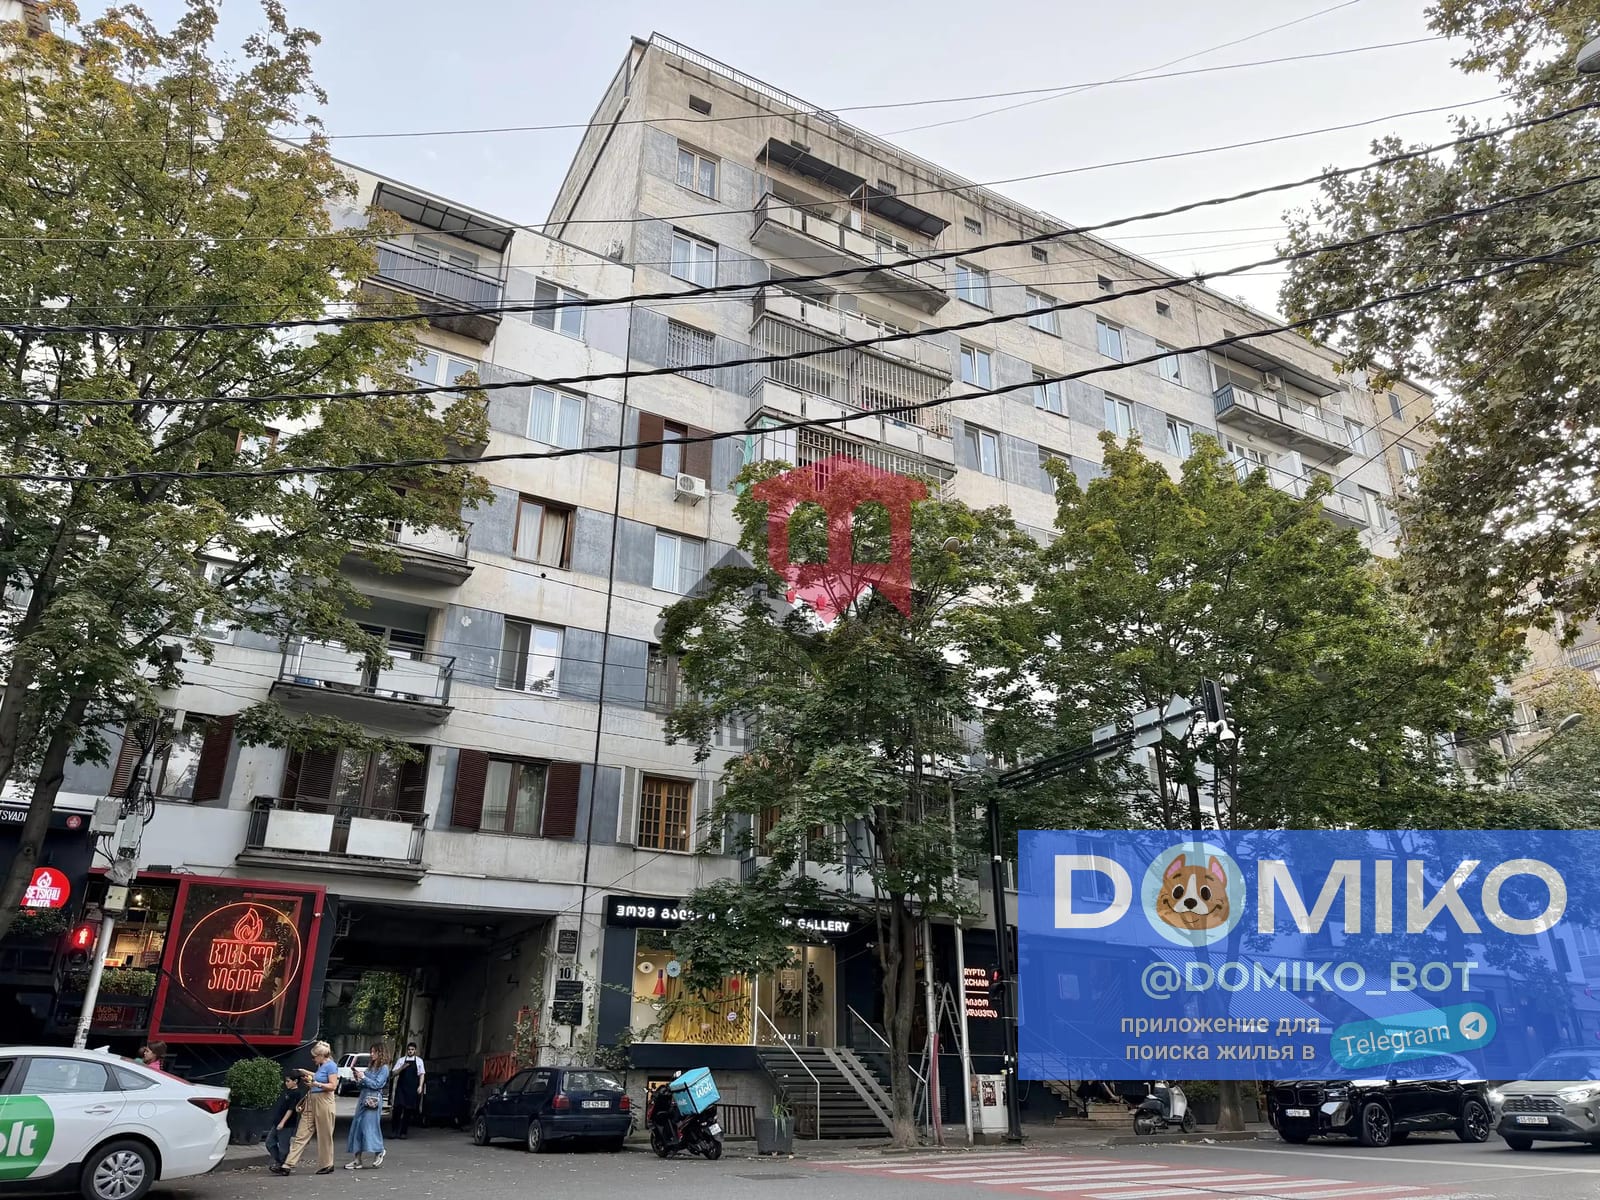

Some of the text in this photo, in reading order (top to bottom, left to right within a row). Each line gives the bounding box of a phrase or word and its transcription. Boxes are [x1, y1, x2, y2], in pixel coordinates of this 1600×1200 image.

[616, 904, 656, 919] ჰოუმ
[797, 917, 850, 933] GALLERY
[209, 942, 275, 968] ცეცხლი
[207, 966, 266, 992] აინთო
[559, 967, 572, 980] 10
[963, 967, 986, 977] RYPTO
